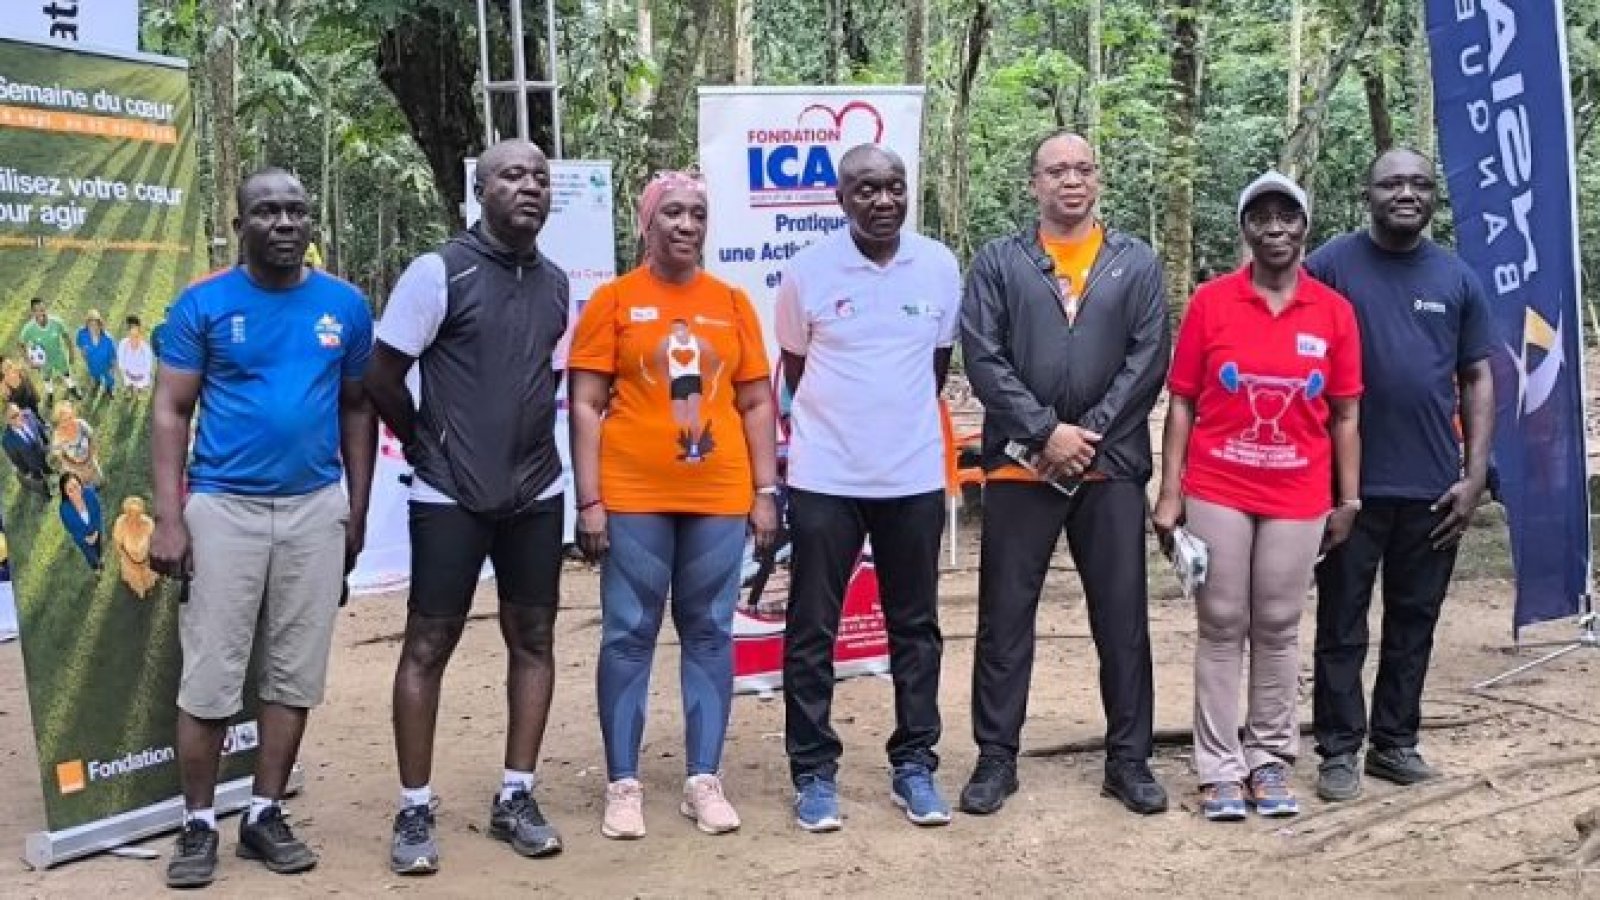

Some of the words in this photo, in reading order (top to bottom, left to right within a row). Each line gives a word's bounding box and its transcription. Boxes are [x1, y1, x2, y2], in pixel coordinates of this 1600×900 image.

[93, 90, 121, 112] du
[747, 129, 841, 143] FONDATION
[747, 145, 838, 190] ICA
[0, 167, 63, 197] ilisez
[69, 176, 127, 199] votre
[135, 183, 184, 206] cœur
[0, 202, 33, 224] our
[40, 201, 87, 230] agir
[718, 247, 756, 263] une
[766, 271, 783, 288] et
[88, 746, 175, 781] Fondation
